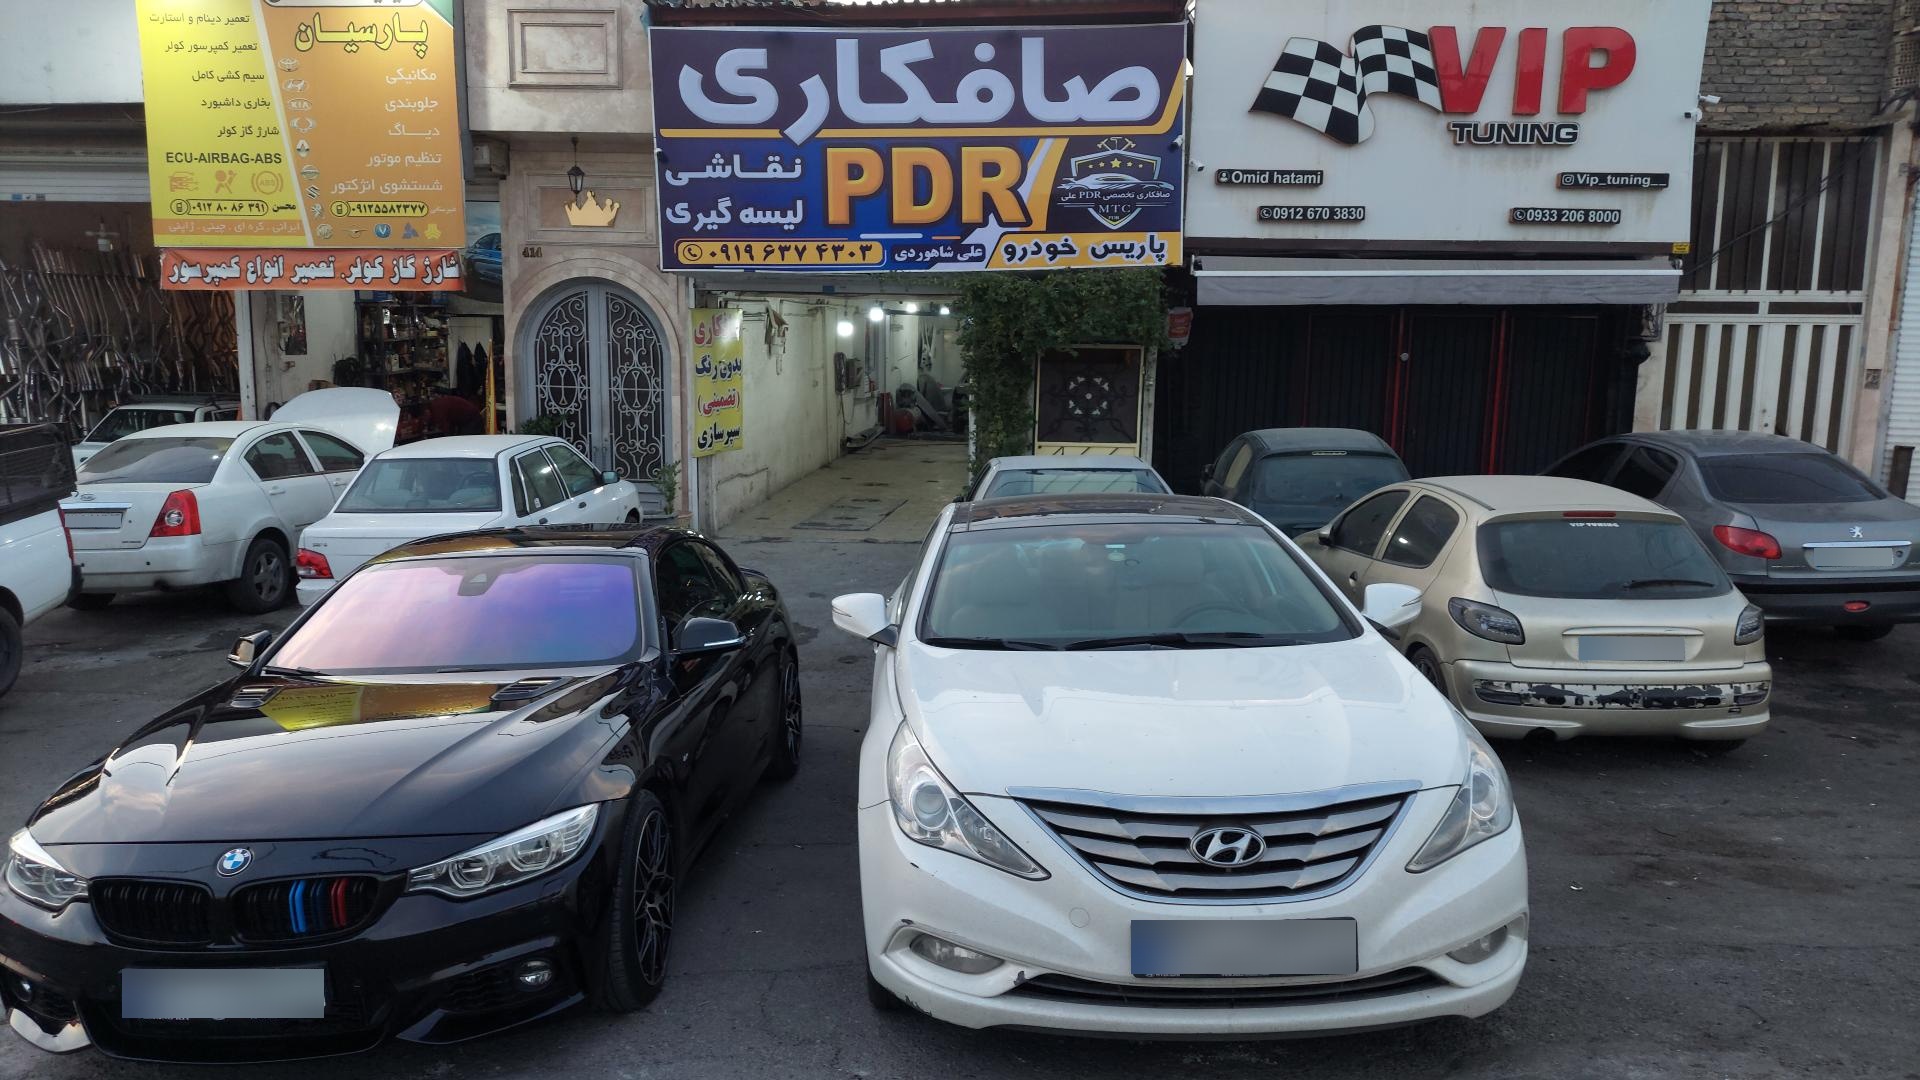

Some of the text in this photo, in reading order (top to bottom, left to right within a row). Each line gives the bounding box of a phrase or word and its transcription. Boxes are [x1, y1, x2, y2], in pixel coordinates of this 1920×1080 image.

[149, 12, 185, 24] استارت
[196, 13, 222, 25] دینام
[224, 14, 250, 25] تعمیر
[295, 12, 428, 59] پارسیان
[165, 41, 258, 54] تعمیر کمپرسور کولر
[192, 70, 265, 83] سیم کشی کامل
[385, 68, 437, 85] مکانیکی
[1428, 26, 1637, 115] VIP
[678, 37, 1162, 146] صافکاری
[201, 97, 271, 110] بخاری داشبورد
[385, 97, 439, 112] جلوبندی
[217, 125, 280, 138] شارژ گاز کولر
[388, 122, 440, 139] دیاگ
[1449, 122, 1580, 145] TUNING
[166, 152, 282, 164] ECU-AIRBAG-ABS
[366, 152, 441, 167] تنظیم موتور
[665, 153, 801, 186] نقاشی
[1231, 171, 1321, 184] Omid hatami
[331, 178, 442, 195] شستشوی انژکتور
[827, 145, 1028, 226] PDR
[1061, 191, 1171, 201] صافکاری تخصصی PDR علی
[272, 203, 297, 213] محسن
[666, 197, 803, 232] لیسه گیری
[1099, 204, 1131, 213] MTC
[1273, 208, 1364, 220] 0912 670 3830
[1526, 209, 1619, 223] 0933 206 8000
[709, 243, 873, 262] ۰۹۱۹ ۶۳۷ ۴۳۰۳
[895, 244, 983, 262] علی شاهوردی
[1004, 234, 1166, 262] پاریس خودرو
[168, 256, 241, 286] کمپرسور
[246, 255, 284, 285] انواع
[290, 255, 336, 285] تعمیر
[389, 255, 416, 285] گاز
[422, 256, 460, 285] شارژ
[697, 421, 724, 449] سازی
